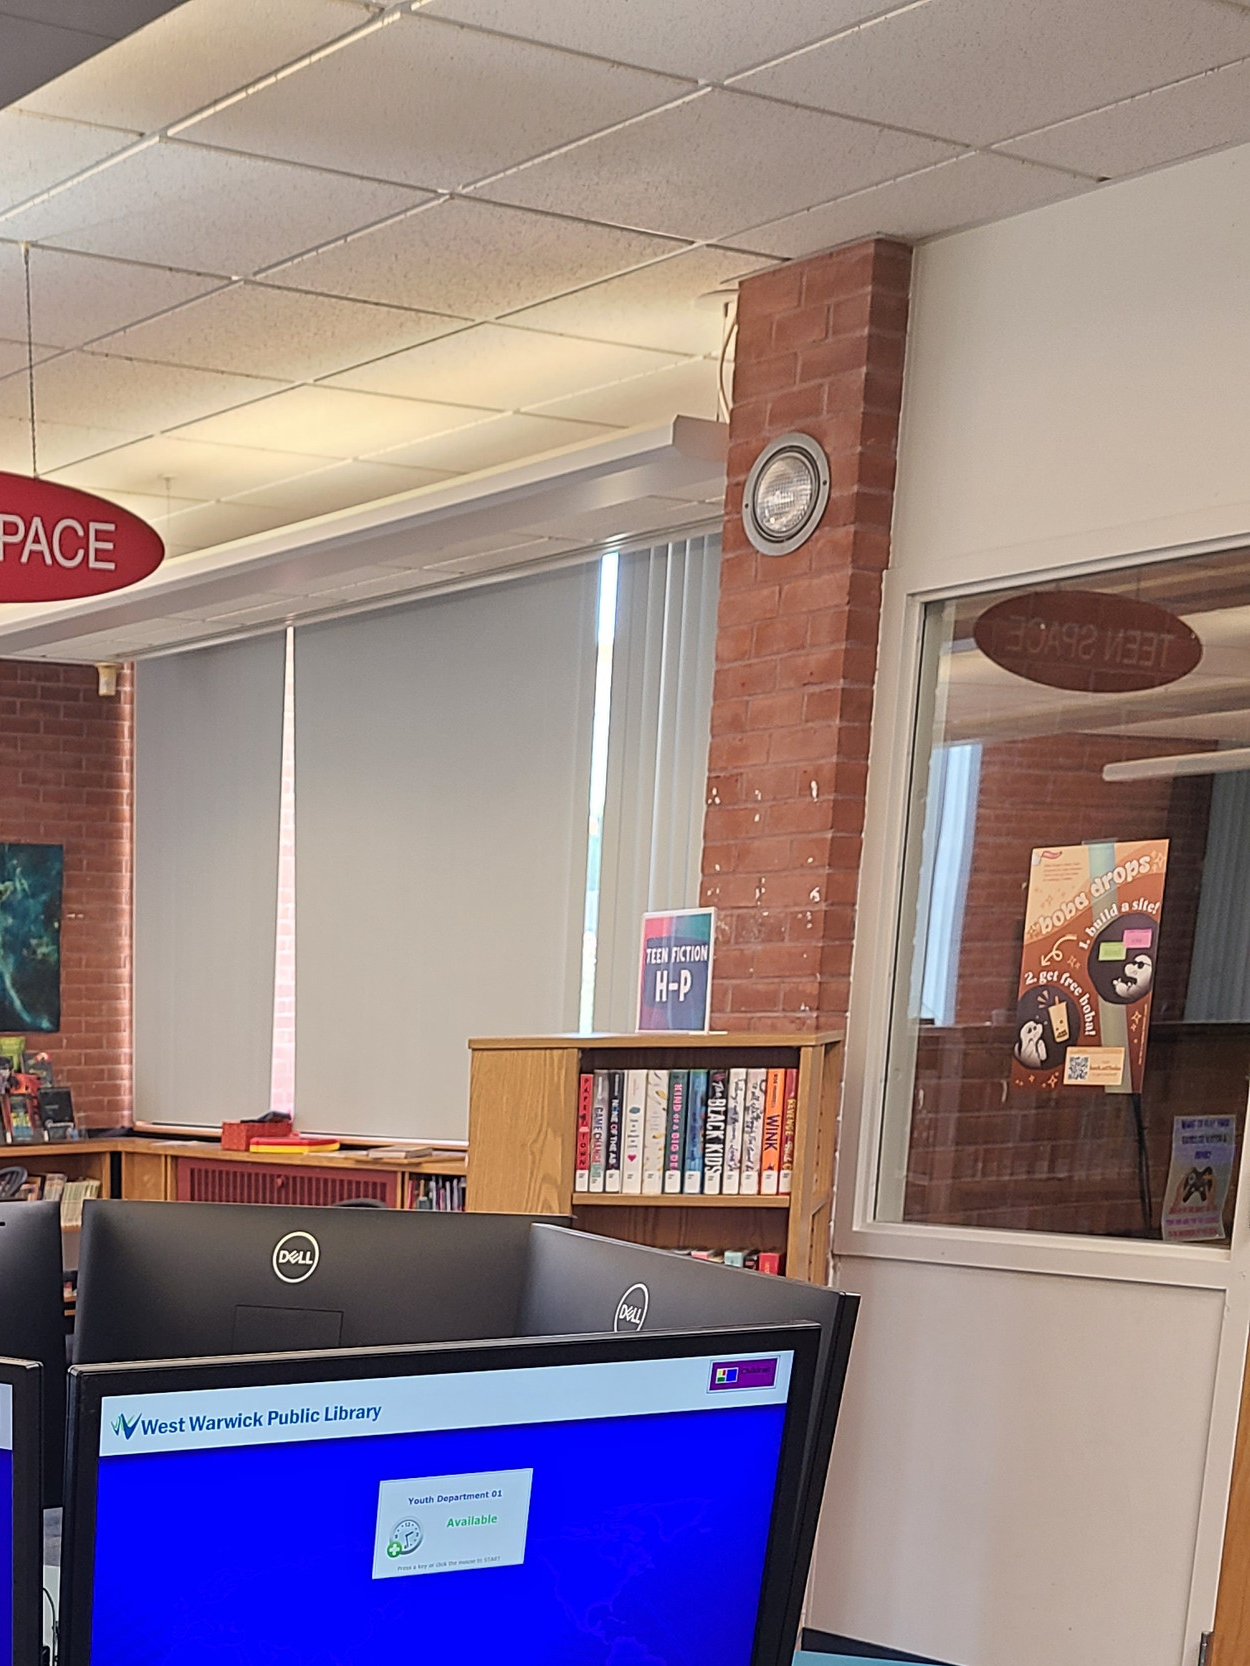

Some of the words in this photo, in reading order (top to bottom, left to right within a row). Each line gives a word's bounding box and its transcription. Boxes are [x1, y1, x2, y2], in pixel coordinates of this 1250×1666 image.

[1038, 896, 1089, 935] boba
[1090, 855, 1151, 898] drops
[1085, 903, 1118, 937] build
[1121, 902, 1129, 912] a
[1132, 898, 1161, 915] site!
[646, 946, 669, 965] TEEN
[671, 944, 708, 963] FICTION
[1038, 970, 1059, 984] get
[1059, 972, 1082, 997] free
[1079, 996, 1096, 1037] boba!
[672, 1084, 683, 1111] KIND
[711, 1081, 724, 1098] The
[706, 1099, 726, 1140] BLACK
[784, 1098, 796, 1136] REVENGE
[670, 1133, 680, 1152] BIG
[764, 1114, 781, 1151] WINK
[704, 1143, 724, 1174] KIDS
[279, 1250, 313, 1264] DELL
[619, 1304, 641, 1324] DELL
[141, 1417, 186, 1435] West
[189, 1412, 263, 1432] Warwick
[267, 1408, 320, 1427] Public
[324, 1405, 382, 1423] Library
[408, 1495, 434, 1505] Youth
[437, 1491, 489, 1504] Department
[492, 1490, 502, 1498] 01
[447, 1514, 497, 1528] Available
